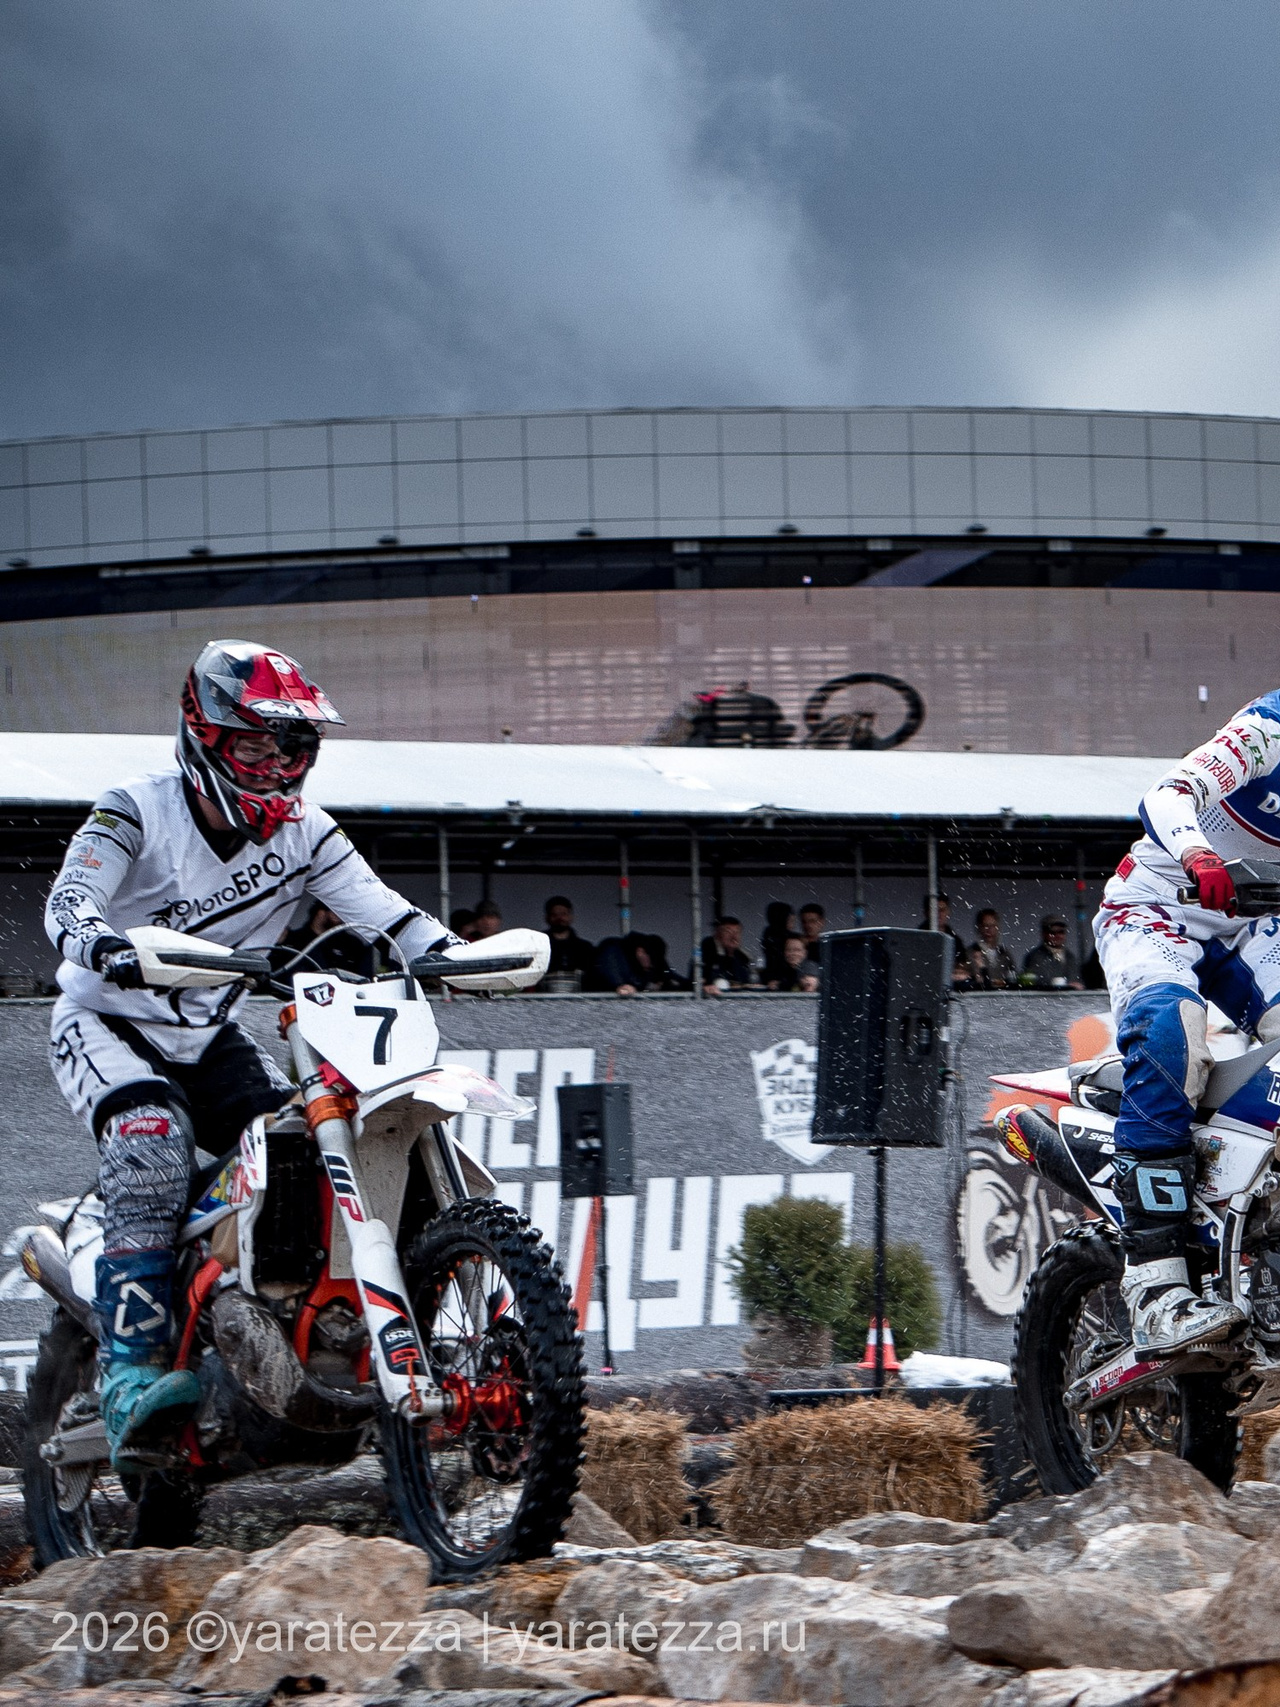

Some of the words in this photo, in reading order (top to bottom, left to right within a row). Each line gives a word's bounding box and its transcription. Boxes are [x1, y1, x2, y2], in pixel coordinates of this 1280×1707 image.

[354, 1006, 398, 1065] 7
[1088, 1131, 1116, 1144] SHISH
[1136, 1167, 1188, 1212] G
